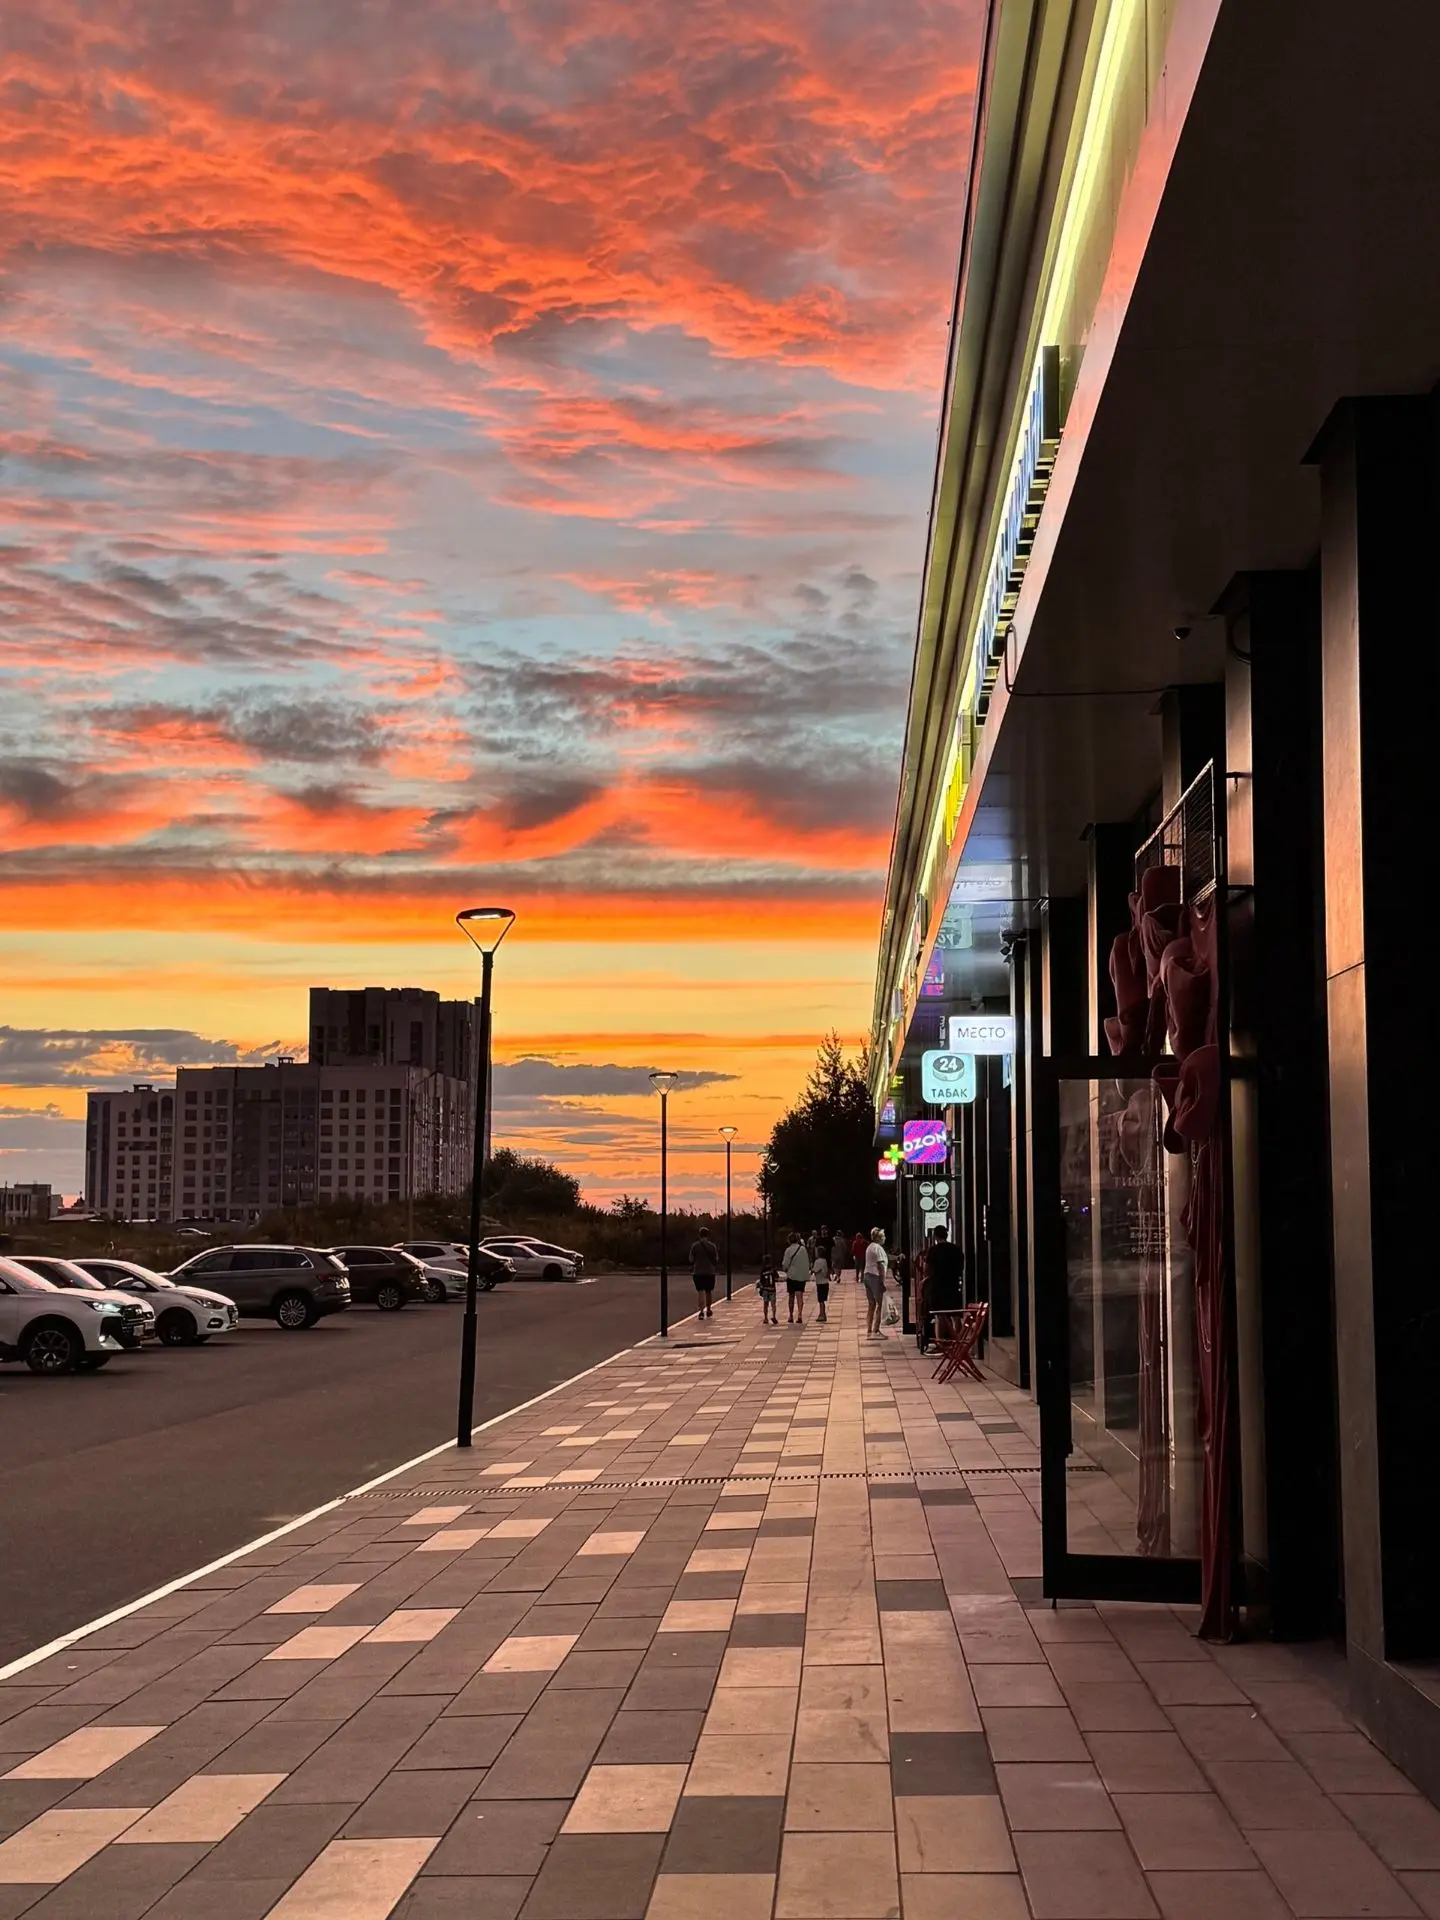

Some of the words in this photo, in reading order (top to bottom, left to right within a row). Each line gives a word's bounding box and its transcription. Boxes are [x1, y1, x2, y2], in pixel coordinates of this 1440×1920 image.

[957, 1026, 1006, 1039] МЕСТО
[939, 1057, 958, 1071] 24
[931, 1088, 968, 1098] ТАБАК
[904, 1131, 947, 1152] OZON
